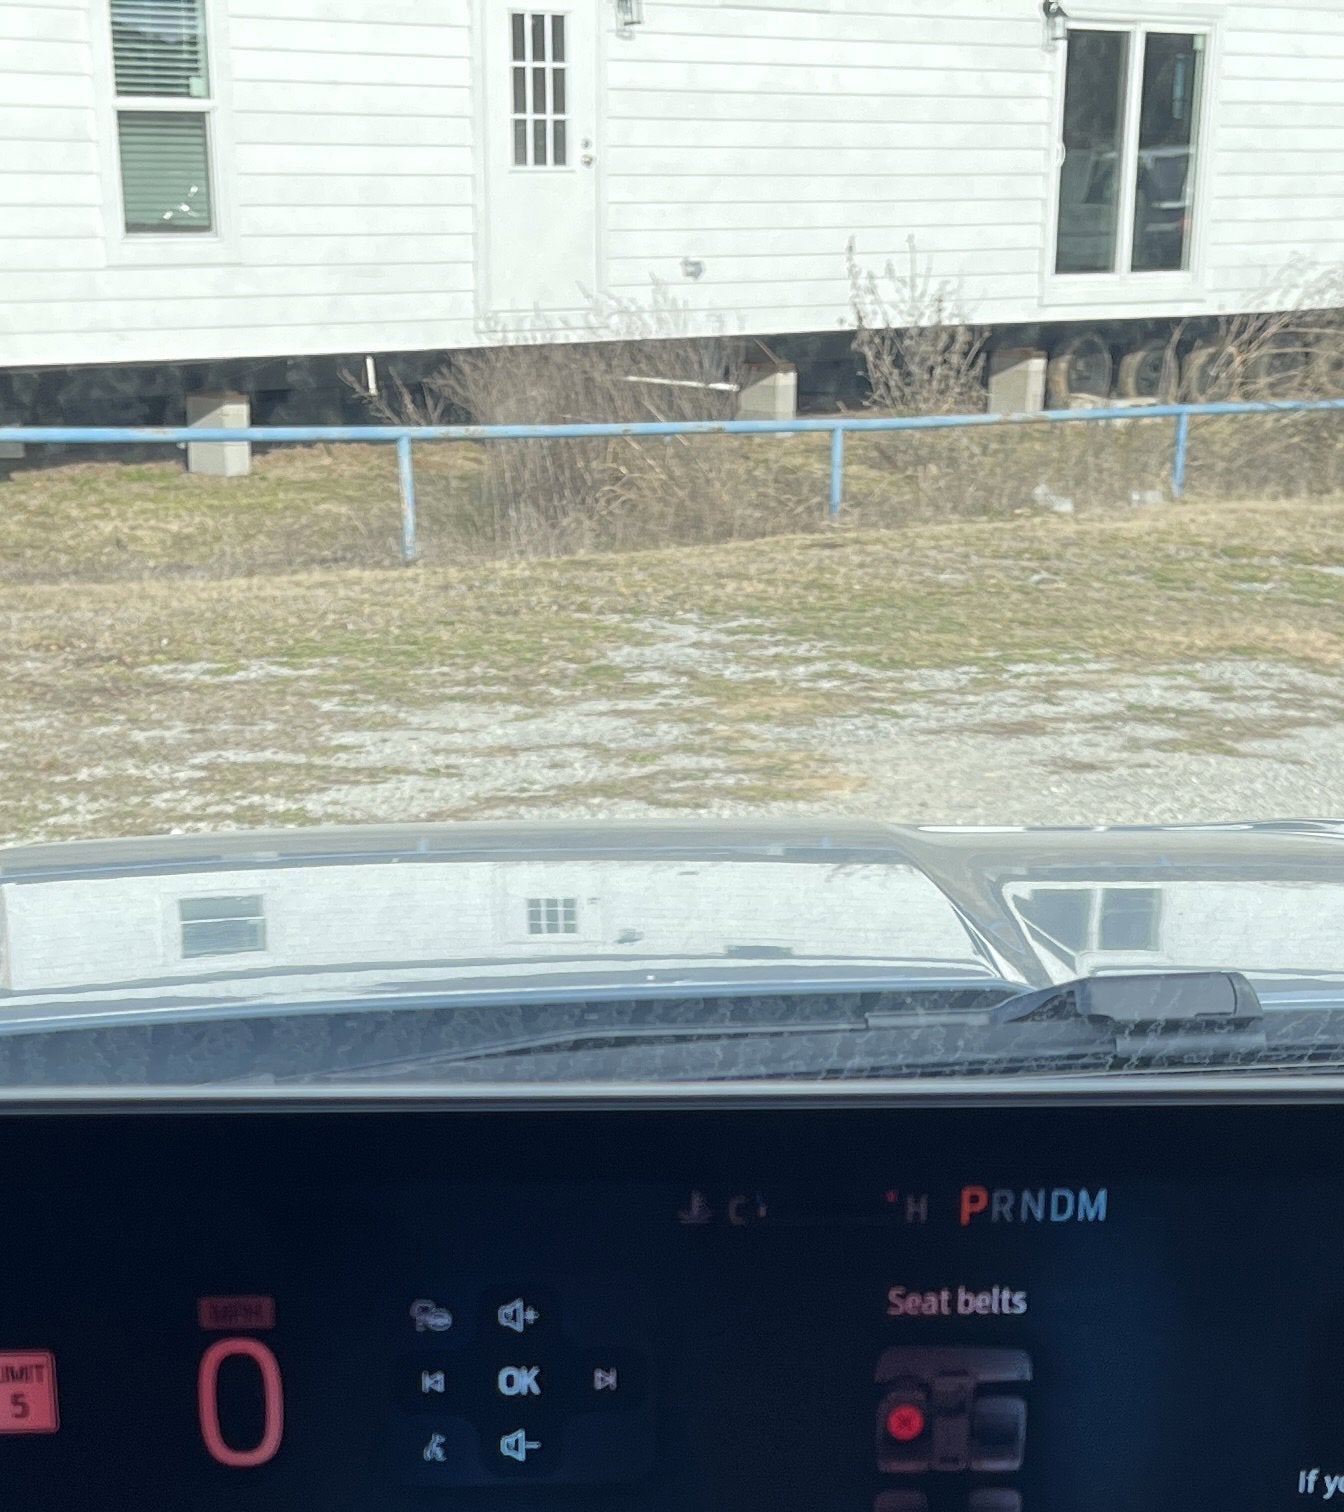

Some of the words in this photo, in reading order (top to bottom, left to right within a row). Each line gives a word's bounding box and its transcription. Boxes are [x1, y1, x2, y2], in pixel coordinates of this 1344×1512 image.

[887, 1285, 951, 1316] Seat
[957, 1284, 1028, 1316] belts
[498, 1365, 542, 1396] OK
[10, 1392, 31, 1419] 5
[197, 1336, 285, 1468] 0
[1298, 1468, 1319, 1494] If
